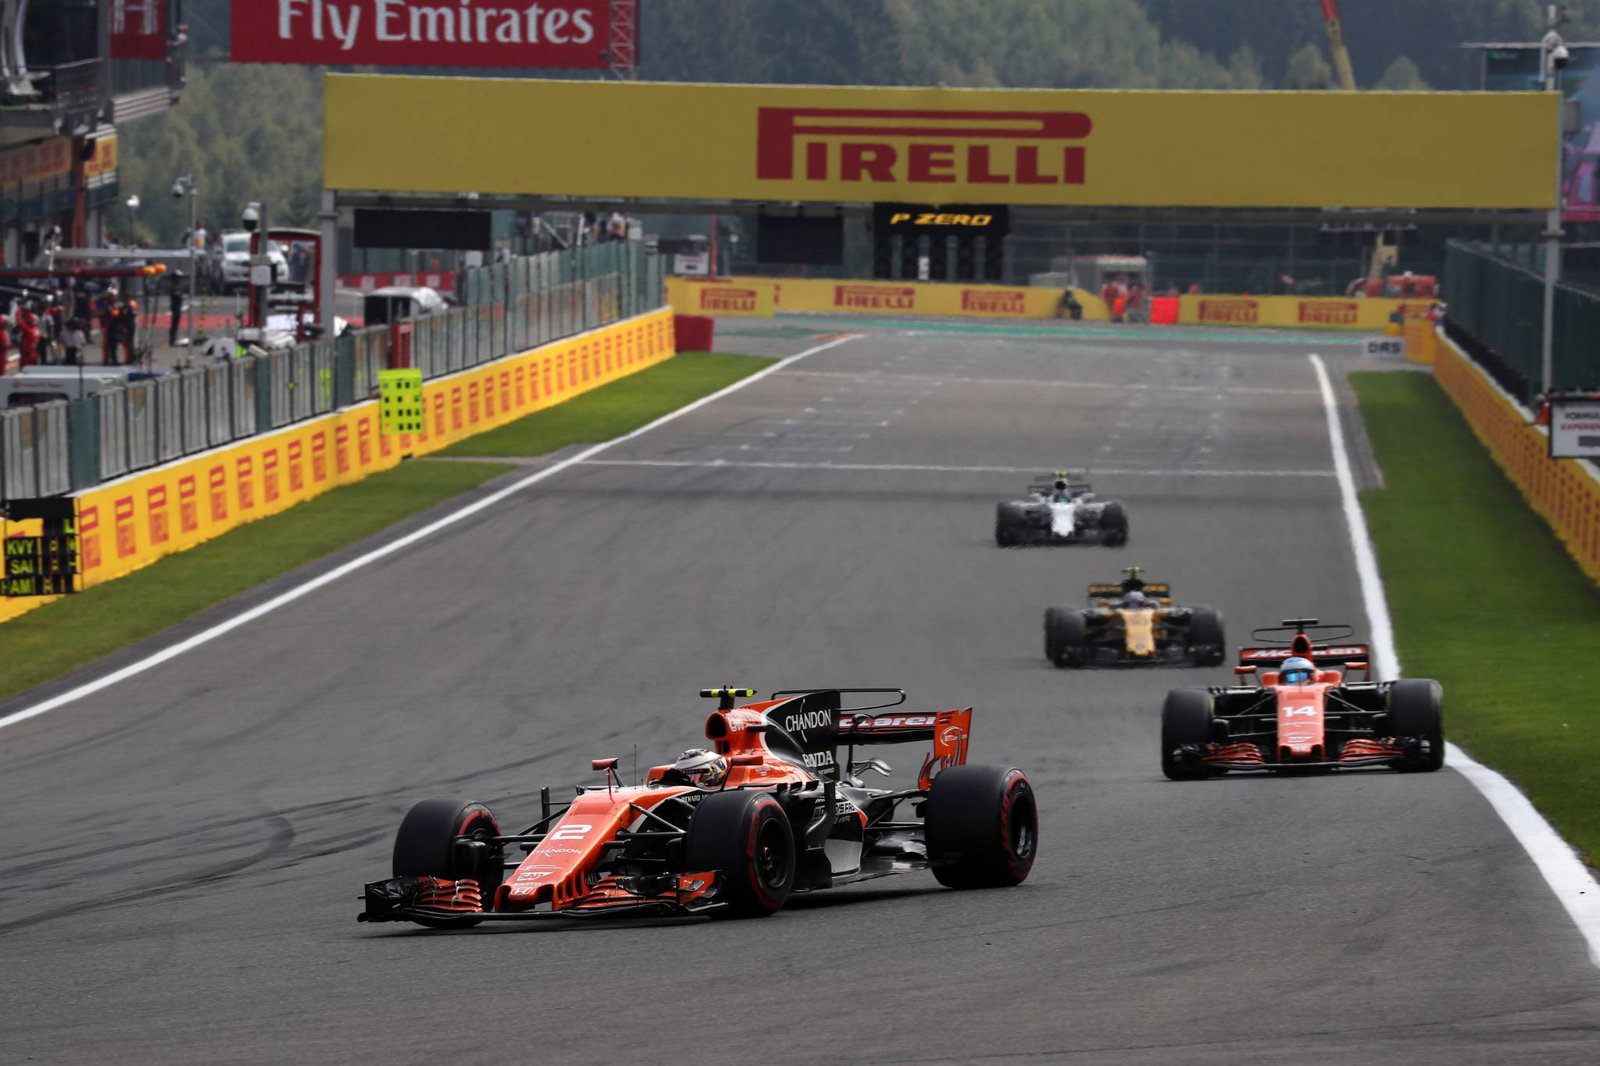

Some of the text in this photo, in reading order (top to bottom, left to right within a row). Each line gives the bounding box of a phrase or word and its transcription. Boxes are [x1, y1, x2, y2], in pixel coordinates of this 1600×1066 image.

[278, 0, 595, 50] Fly Emirates
[757, 107, 1092, 184] PIRELLI
[890, 214, 992, 226] P ZERO
[700, 287, 756, 311] PIRELLI
[834, 285, 915, 309] PIRELLI
[961, 290, 1025, 314] PIRELLI
[7, 540, 34, 555] KVY
[11, 560, 34, 574] SAI
[785, 708, 832, 733] CHANDON
[1282, 706, 1318, 717] 14
[549, 824, 593, 840] 2
